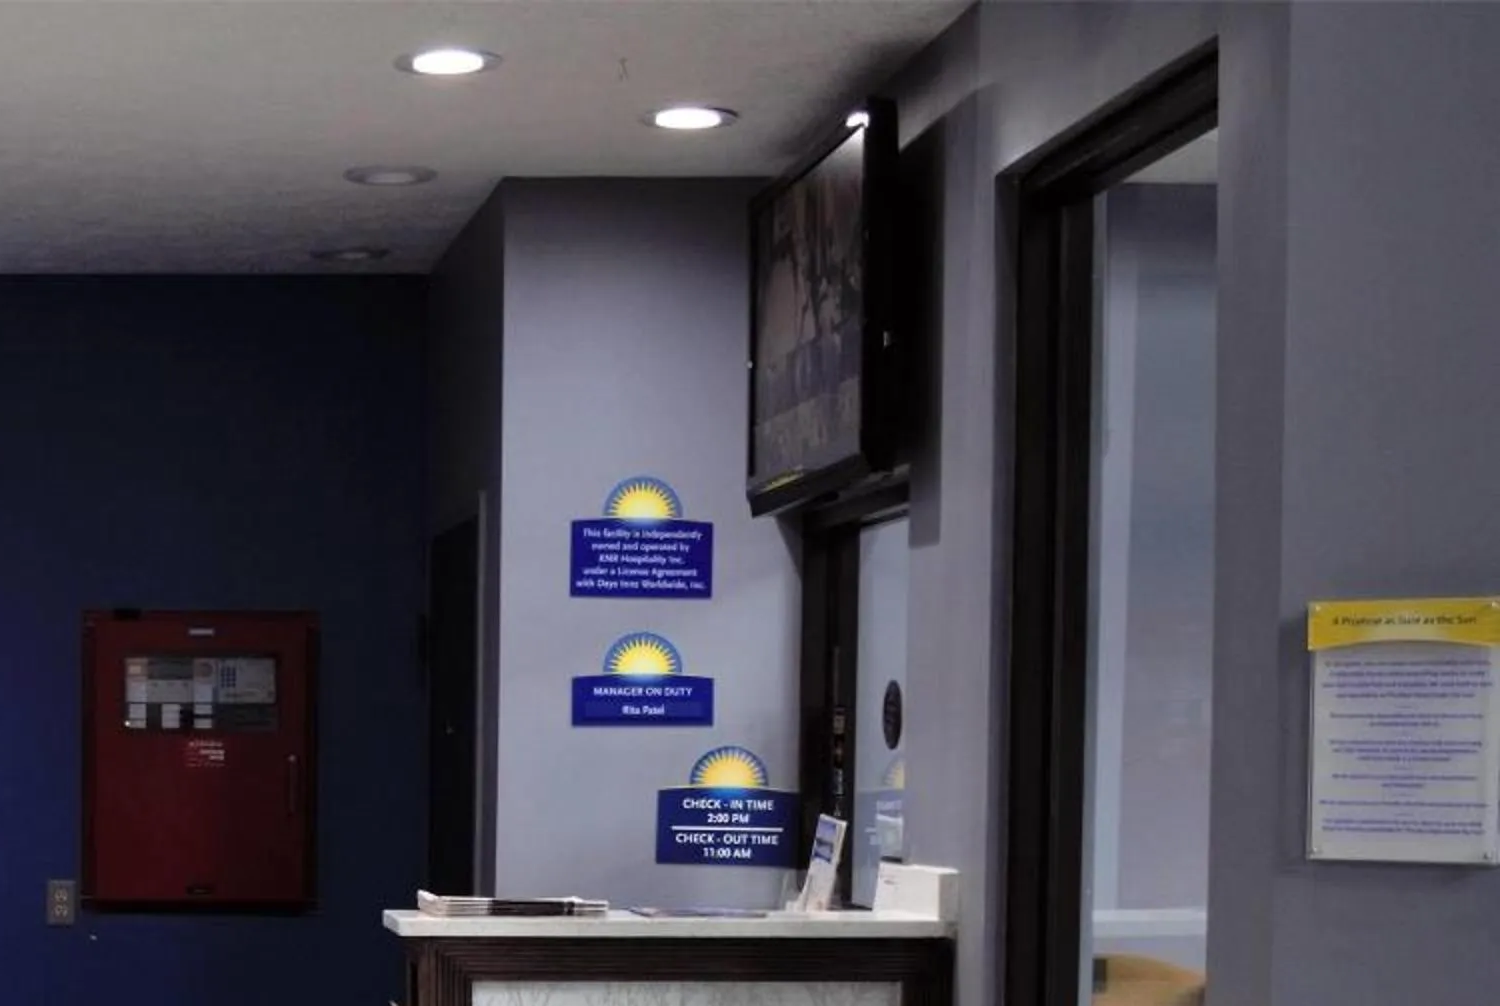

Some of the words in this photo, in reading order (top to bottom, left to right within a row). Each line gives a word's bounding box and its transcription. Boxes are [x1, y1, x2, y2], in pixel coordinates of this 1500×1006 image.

[583, 528, 601, 537] This
[603, 528, 631, 539] facility
[642, 529, 703, 541] independently
[591, 542, 620, 551] owned
[622, 542, 638, 551] and
[640, 542, 677, 552] operated
[679, 543, 690, 552] by
[583, 567, 608, 576] under
[617, 567, 649, 576] License
[651, 567, 698, 578] Agreement
[575, 578, 595, 588] with
[596, 579, 619, 590] Days
[593, 687, 643, 697] MANAGER
[645, 687, 662, 697] ON
[663, 687, 693, 697] DUTY
[621, 705, 641, 715] Rita
[642, 704, 665, 715] Patel
[682, 798, 721, 810] CHECK
[729, 799, 743, 811] IN
[745, 799, 775, 811] TIME
[707, 813, 730, 823] 2:00
[731, 813, 749, 824] PM
[675, 833, 715, 844] CHECK
[723, 833, 749, 845] OUT
[751, 834, 779, 846] TIME
[703, 847, 731, 858] 11:00
[732, 848, 752, 859] AM
